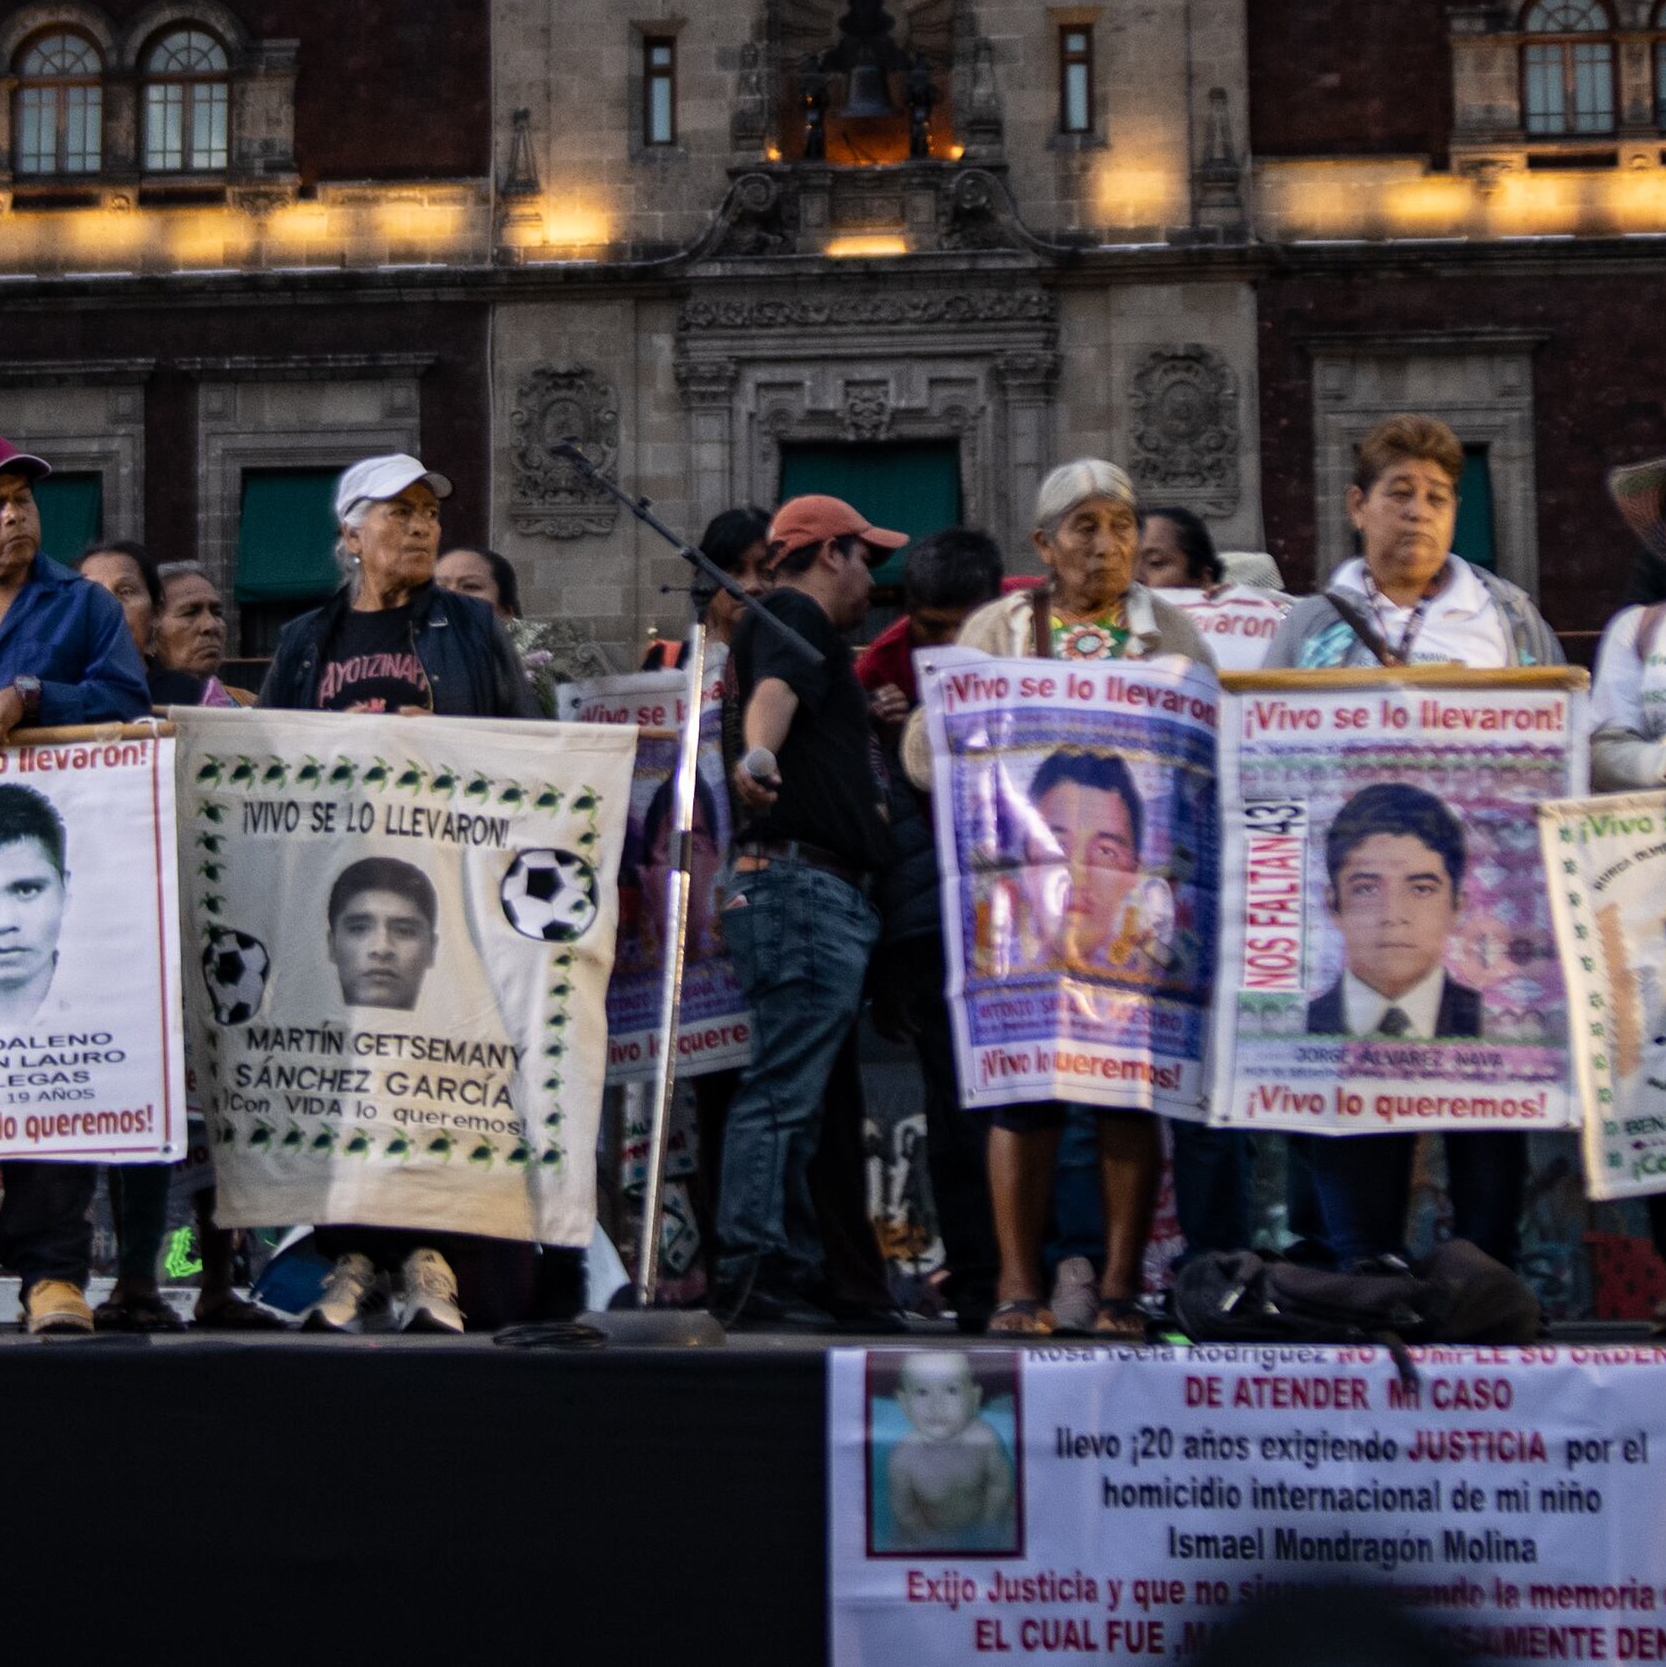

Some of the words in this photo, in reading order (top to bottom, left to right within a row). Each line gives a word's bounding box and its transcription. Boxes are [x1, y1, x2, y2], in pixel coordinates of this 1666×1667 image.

[317, 652, 427, 708] AYOTZINAP
[945, 673, 1010, 712] ¡Vivo
[1020, 677, 1057, 699] se
[1068, 673, 1094, 701] lo
[1105, 676, 1216, 727] llevaron
[637, 705, 666, 726] se
[1245, 699, 1322, 739] ¡Vivo
[1334, 706, 1369, 730] se
[1381, 699, 1409, 730] lo
[1421, 699, 1566, 732] llevaron!
[18, 741, 148, 773] llevaron!
[243, 801, 300, 835] ¡VIVO
[310, 801, 338, 833] SE
[346, 802, 375, 834] LO
[385, 804, 511, 849] LLEVARON!
[1244, 797, 1307, 835] 43!
[1582, 813, 1654, 844] ¡Vivo
[1248, 837, 1302, 927] FALTAN
[1246, 937, 1300, 989] NOS
[21, 1050, 127, 1069] LAURO
[247, 1021, 345, 1054] MARTÍN
[354, 1031, 528, 1072] GETSEMANY
[235, 1055, 372, 1093] SÁNCHEZ
[385, 1071, 515, 1110] GARCÍA
[981, 1045, 1029, 1086] ¡Vivo
[1036, 1044, 1050, 1073] lo
[1053, 1050, 1182, 1091] ueremos!
[7, 1092, 31, 1104] 19
[37, 1088, 96, 1102] AÑOS
[284, 1095, 344, 1118] VIDA
[355, 1100, 378, 1120] lo
[393, 1105, 527, 1138] queremos!
[1247, 1084, 1326, 1119] ¡Vivo
[1335, 1085, 1364, 1116] lo
[1374, 1091, 1547, 1124] queremos!
[25, 1104, 154, 1145] queremos!
[1184, 1376, 1225, 1409] DE
[1233, 1376, 1370, 1411] ATENDER
[1432, 1377, 1513, 1412] CASO
[1055, 1426, 1122, 1460] llevo
[1132, 1427, 1173, 1468] ¡20
[1183, 1429, 1250, 1462] años
[1261, 1430, 1398, 1470] exigiendo
[1407, 1429, 1548, 1464] JUSTICIA
[1565, 1437, 1612, 1471] por
[1623, 1433, 1649, 1464] el
[1102, 1475, 1242, 1511] homicidio
[1251, 1477, 1442, 1514] internacional
[1451, 1480, 1486, 1514] de
[1496, 1480, 1532, 1514] mi
[1540, 1481, 1603, 1515] niño
[1169, 1525, 1266, 1562] Ismael
[1274, 1527, 1434, 1573] Mondragón
[1442, 1529, 1538, 1566] Molina
[906, 1569, 976, 1610] Exijo
[986, 1569, 1099, 1605] Justicia
[1107, 1579, 1124, 1612] y
[1132, 1579, 1185, 1613] que
[1194, 1579, 1231, 1605] no
[1494, 1577, 1520, 1610] la
[1528, 1577, 1657, 1613] memoria
[975, 1619, 1011, 1653] EL
[1021, 1618, 1100, 1654] CUAL
[1107, 1620, 1166, 1655] FUE
